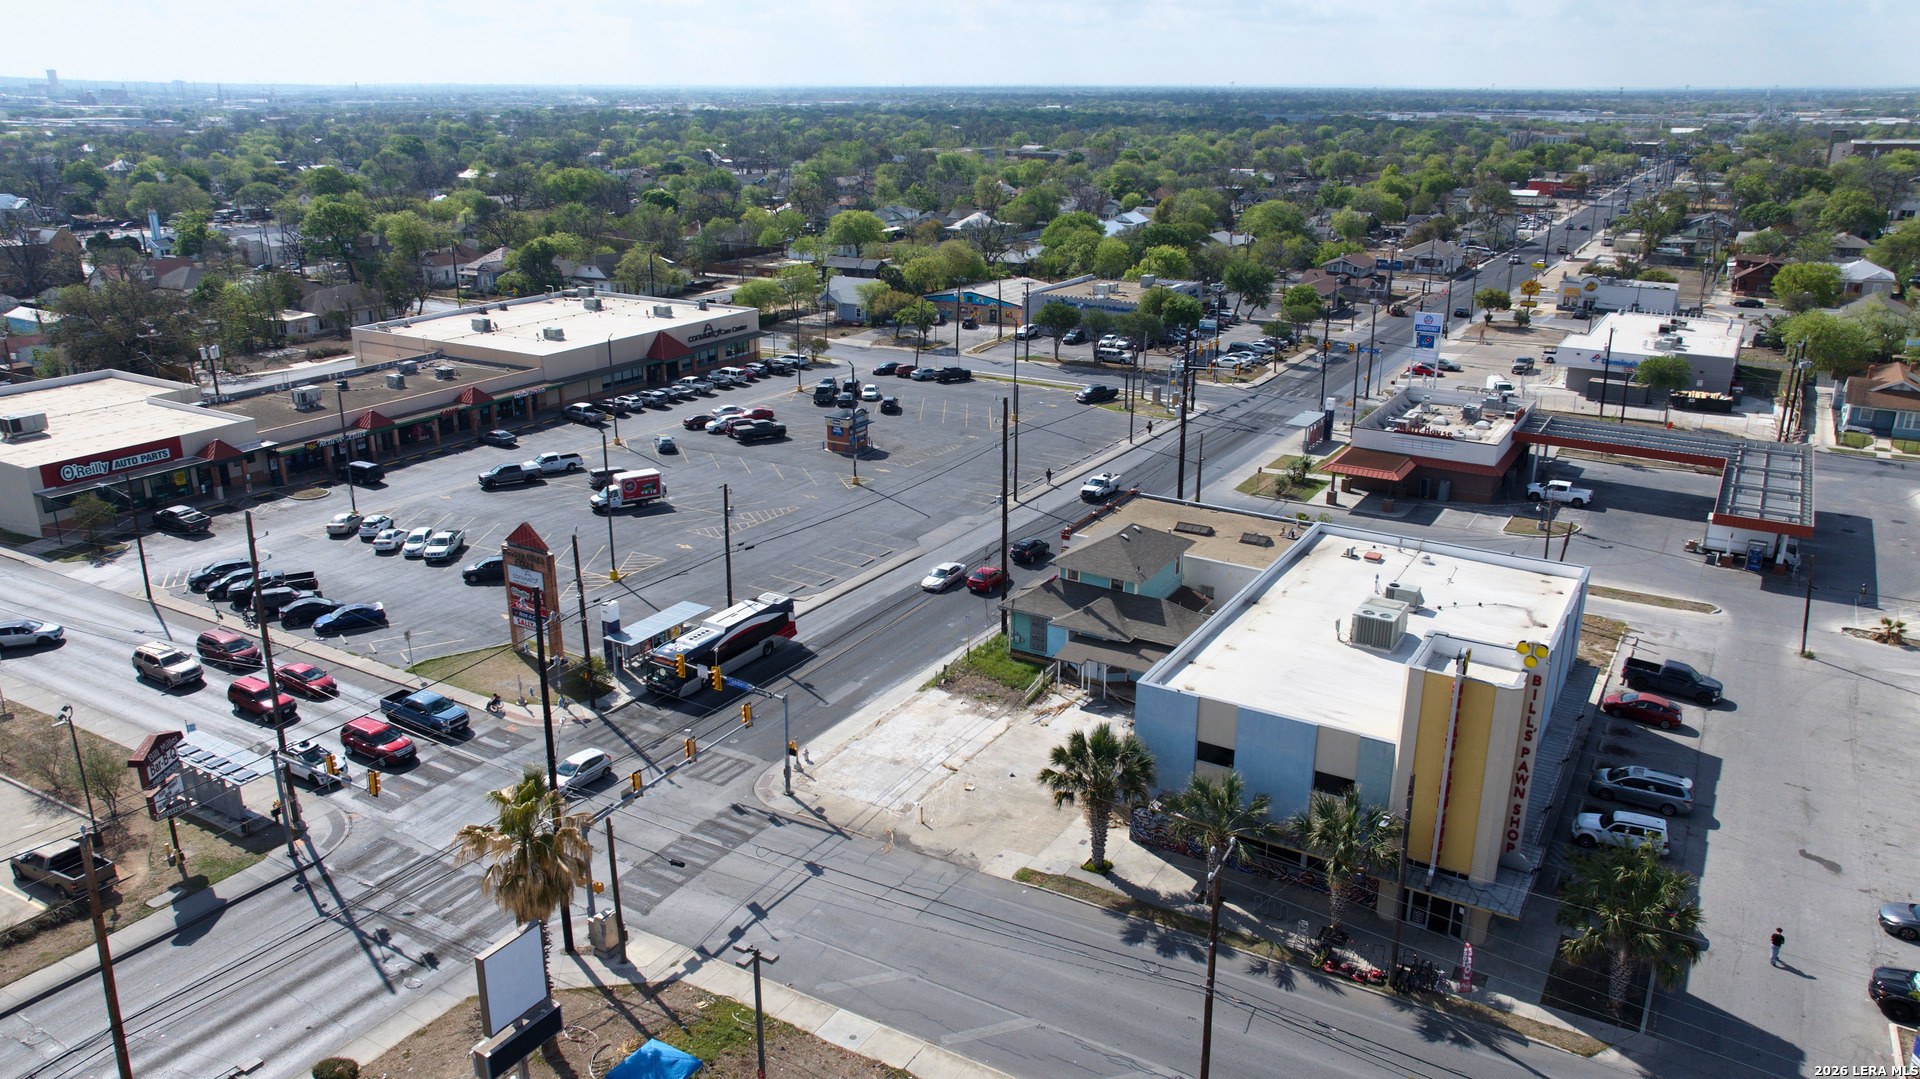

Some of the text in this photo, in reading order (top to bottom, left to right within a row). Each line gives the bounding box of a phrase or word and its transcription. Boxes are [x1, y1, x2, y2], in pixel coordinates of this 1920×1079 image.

[61, 449, 169, 481] O'Reilly AUTO PARTS
[517, 618, 534, 628] SALLY
[148, 735, 178, 762] Bill Miller
[150, 747, 177, 776] Bar-B-Q
[1506, 674, 1542, 853] BILL'S PAWN SHOP
